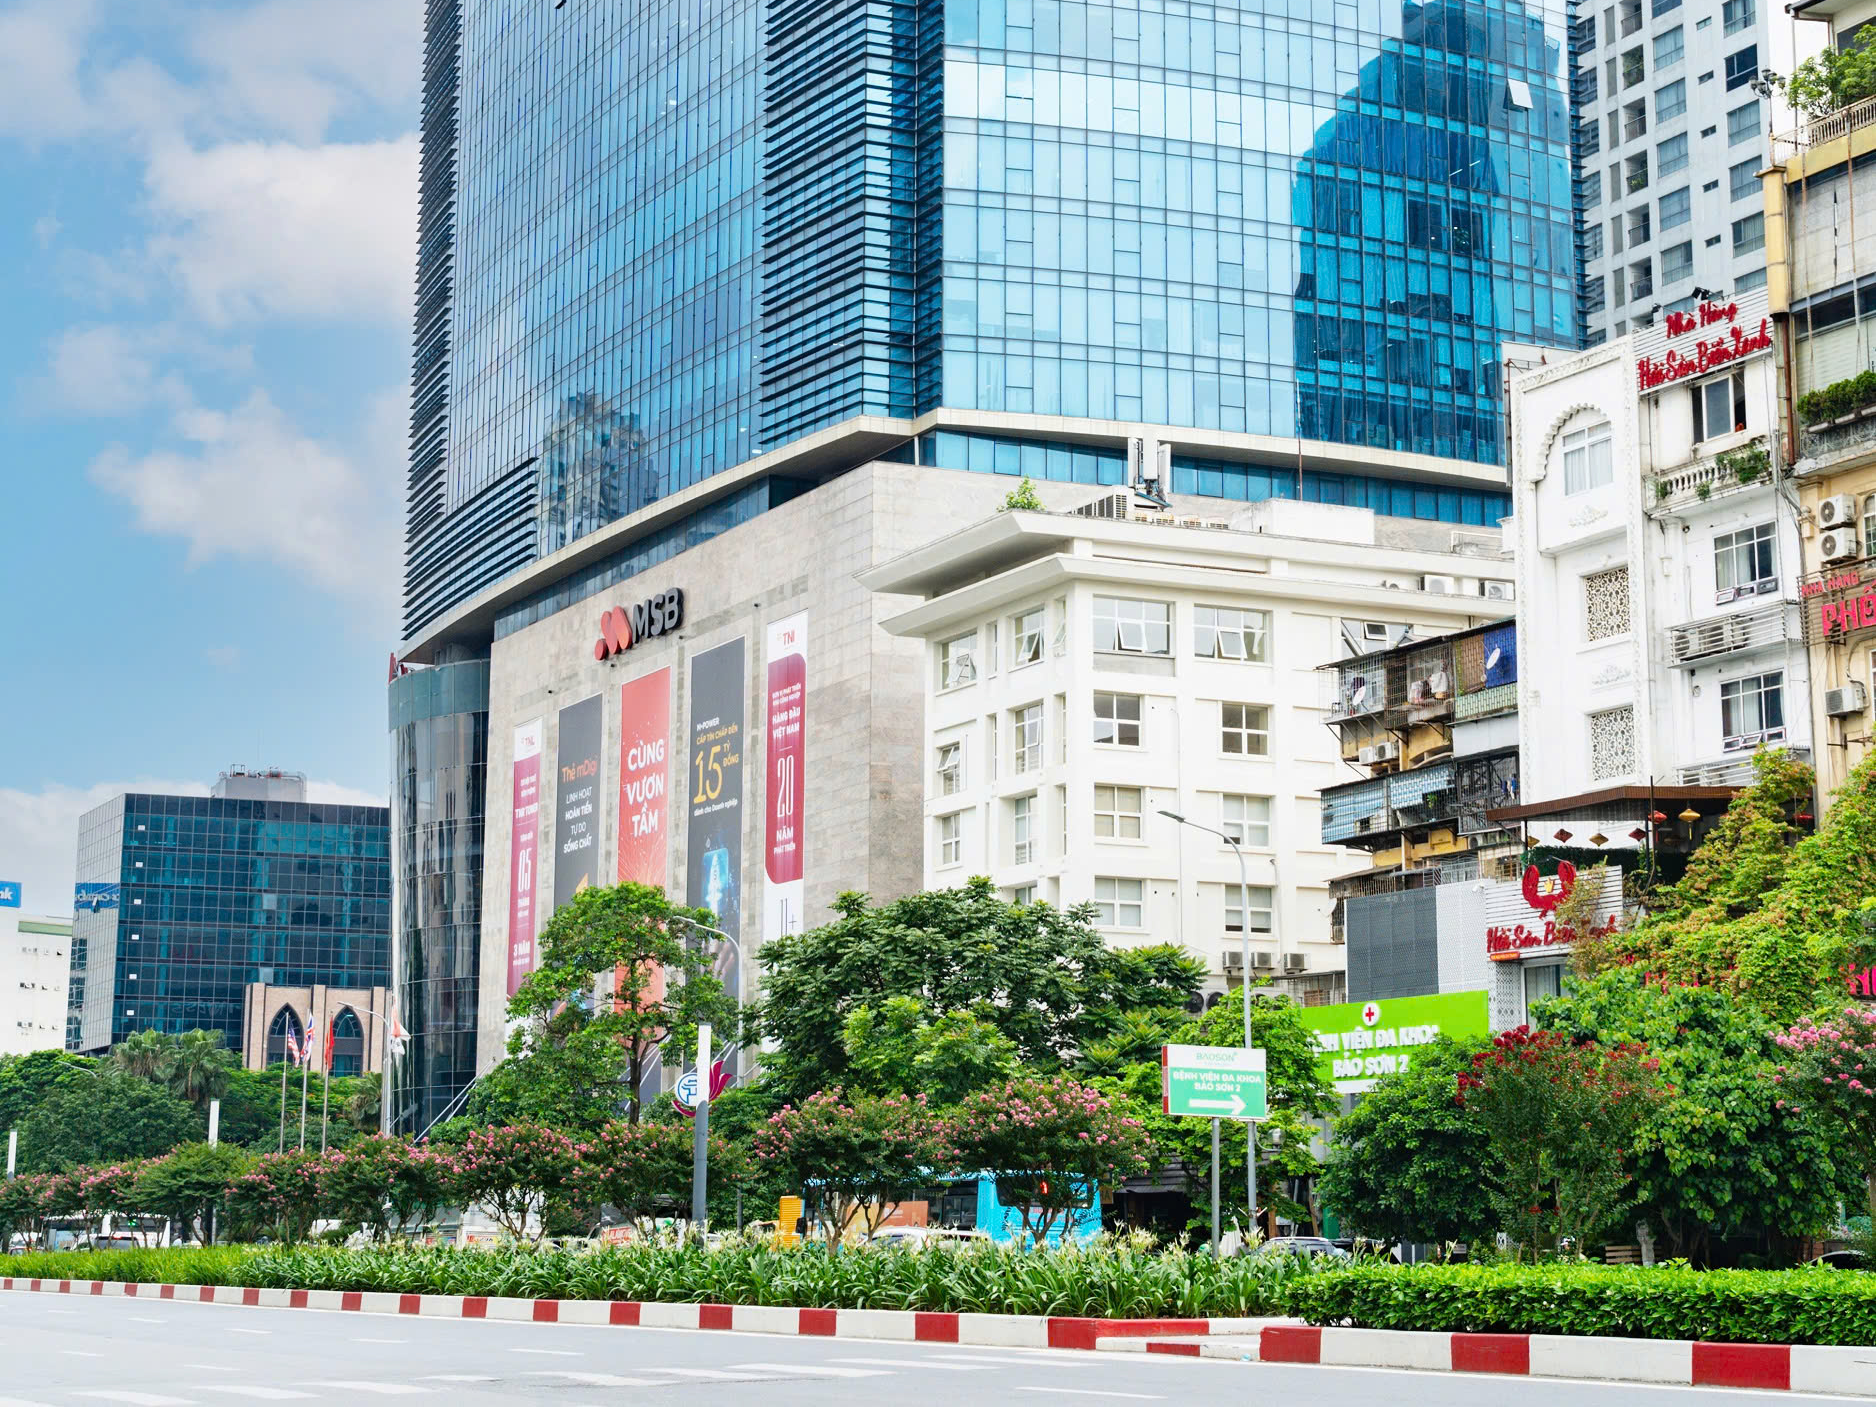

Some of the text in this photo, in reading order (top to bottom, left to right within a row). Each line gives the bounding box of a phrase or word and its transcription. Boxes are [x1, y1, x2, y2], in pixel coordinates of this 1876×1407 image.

[1666, 301, 1738, 338] Nhà Hàng
[633, 587, 684, 644] MSB
[628, 739, 665, 771] CÙNG
[626, 772, 665, 805] VƯƠN
[693, 745, 723, 804] 15
[777, 755, 794, 817] 20
[632, 800, 659, 837] TẦM
[518, 848, 532, 892] 05
[1236, 1075, 1261, 1083] KHOA
[1398, 1054, 1409, 1073] 2
